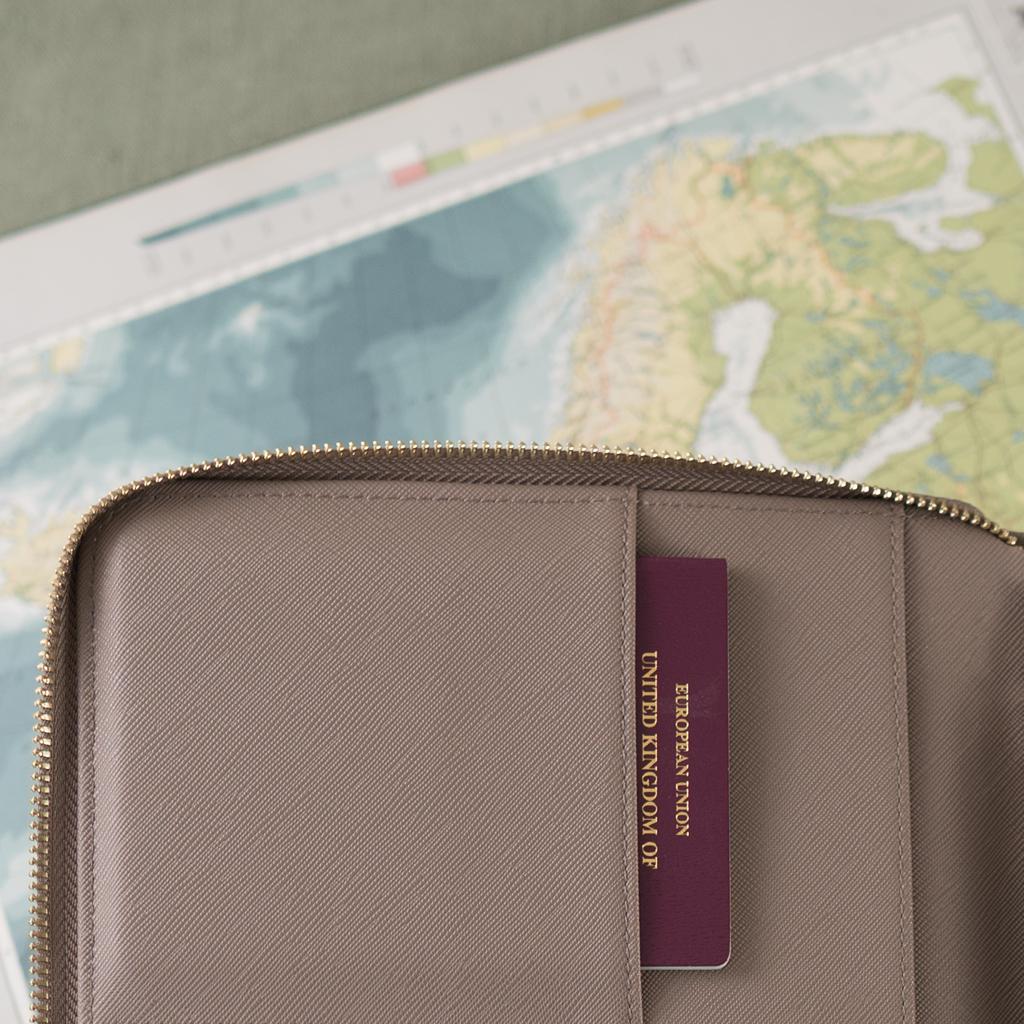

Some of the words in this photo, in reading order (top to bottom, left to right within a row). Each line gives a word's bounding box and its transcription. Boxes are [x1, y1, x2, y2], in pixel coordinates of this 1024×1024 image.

[641, 651, 658, 729] UNITED
[675, 683, 689, 776] EUROPEAN
[641, 734, 658, 836] KINGDOM
[675, 780, 690, 837] UNION
[642, 841, 658, 870] OF
